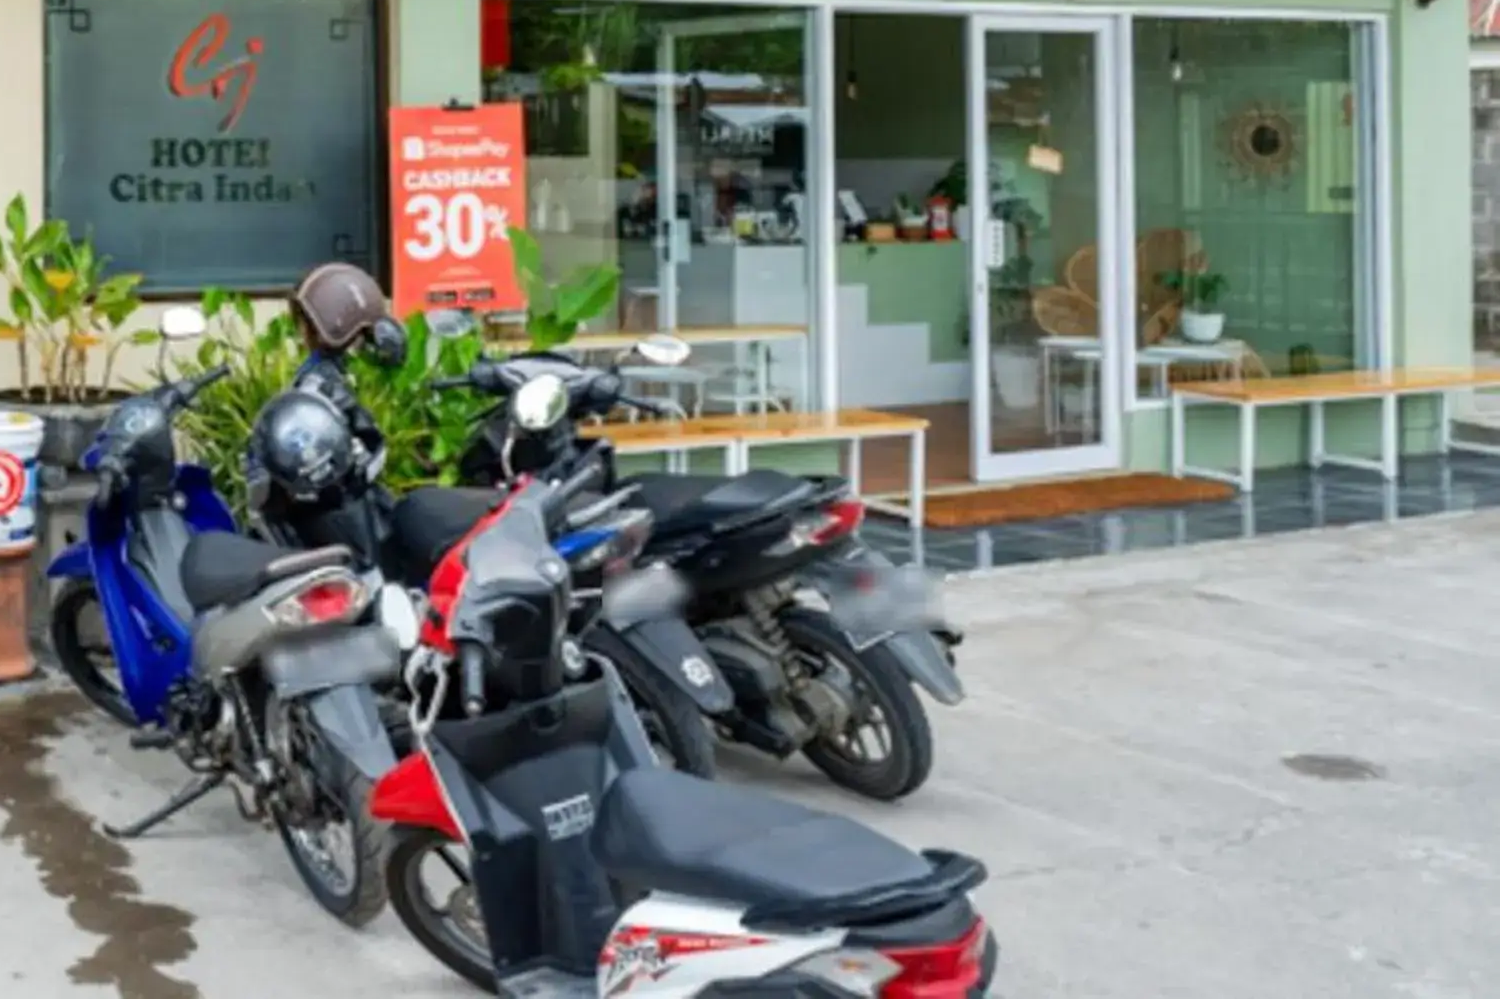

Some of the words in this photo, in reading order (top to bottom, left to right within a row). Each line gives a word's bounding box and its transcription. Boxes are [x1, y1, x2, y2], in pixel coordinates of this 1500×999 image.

[109, 173, 204, 203] Citra
[403, 167, 511, 191] CASHBACK
[404, 192, 510, 262] 30%
